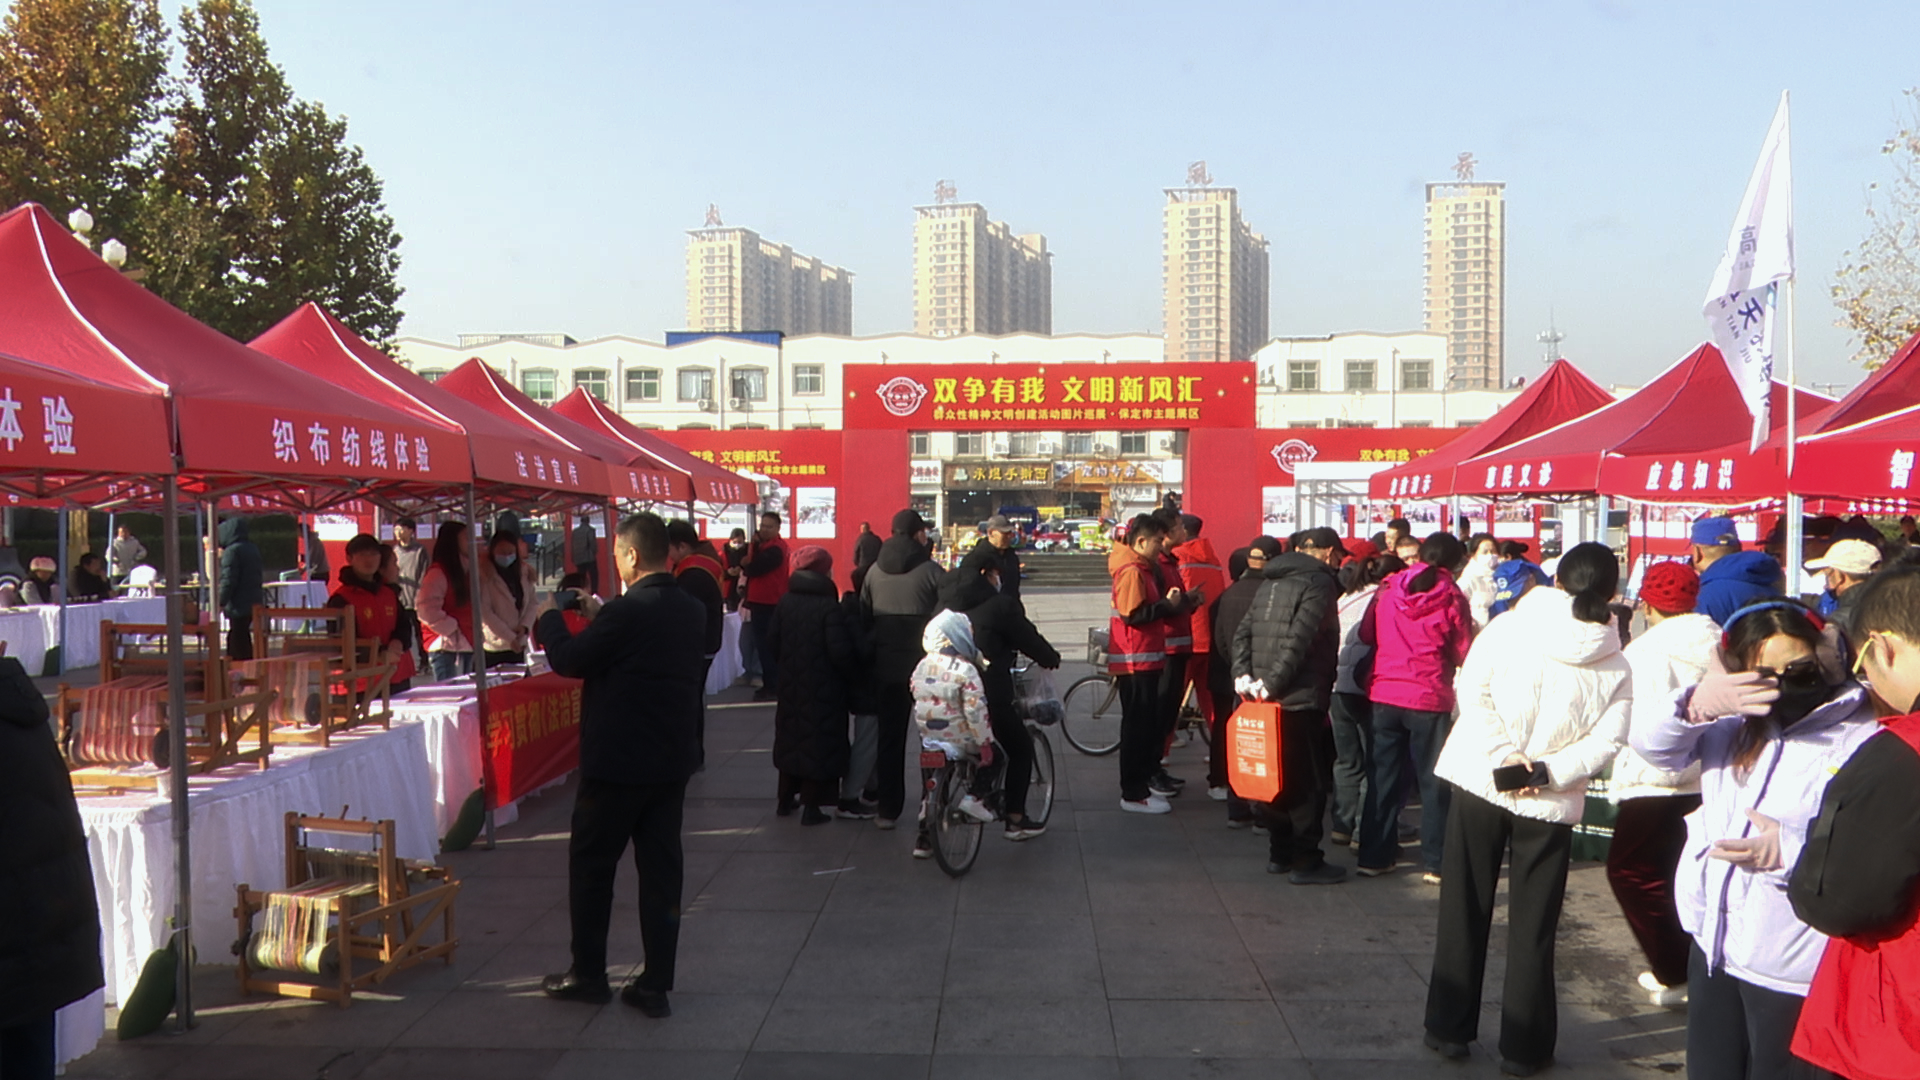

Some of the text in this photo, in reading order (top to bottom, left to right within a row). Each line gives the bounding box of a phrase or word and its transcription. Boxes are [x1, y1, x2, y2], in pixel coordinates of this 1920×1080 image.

[1738, 224, 1757, 256] 高
[1726, 314, 1740, 340] TIAN
[1737, 297, 1764, 330] 天
[932, 376, 1046, 404] 双争有我
[1060, 376, 1203, 403] 文明新风汇
[271, 417, 431, 472] 织布纺线体验
[719, 450, 782, 463] 文明新风汇
[1360, 448, 1411, 462] 双争有我
[514, 451, 579, 486] 法治宣传
[1484, 461, 1552, 488] 惠民义诊
[1644, 458, 1735, 491] 应急知识
[1889, 448, 1915, 489] 智
